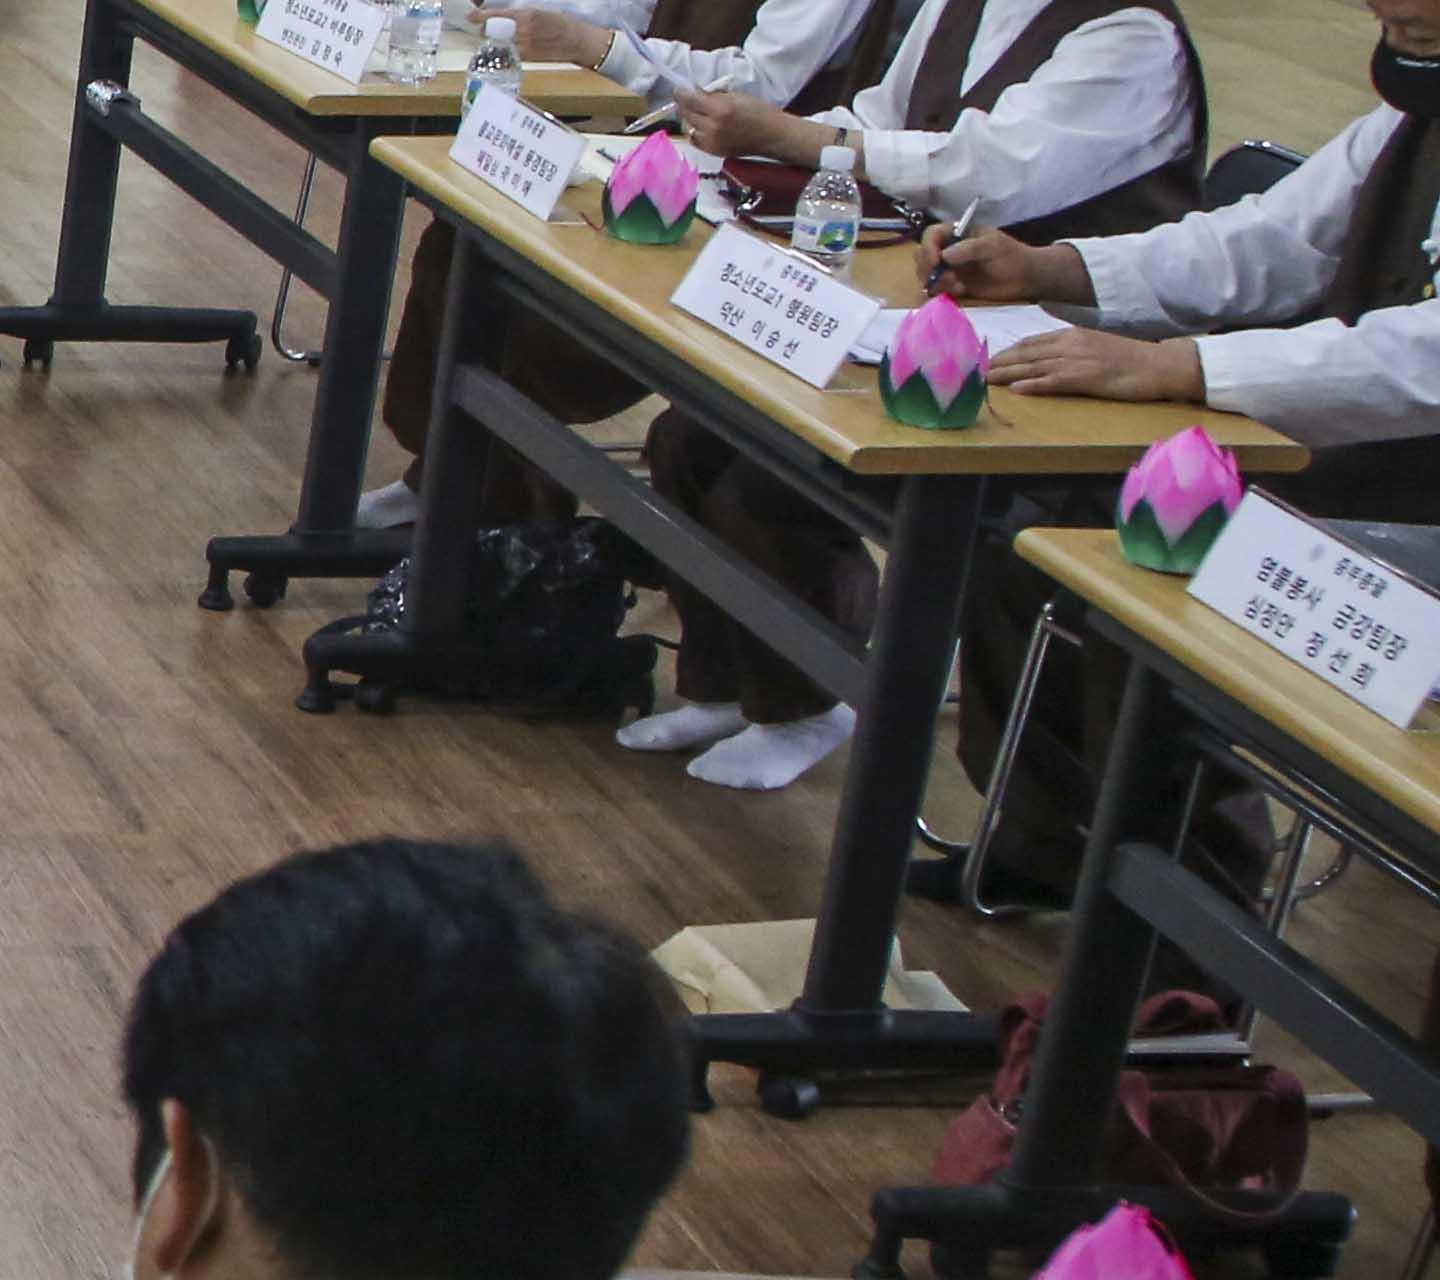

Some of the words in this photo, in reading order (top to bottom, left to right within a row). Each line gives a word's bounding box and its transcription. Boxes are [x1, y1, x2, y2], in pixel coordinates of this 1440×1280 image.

[720, 263, 784, 309] 청소년포교1
[720, 301, 744, 327] 덕산
[752, 320, 766, 340] 이
[765, 331, 780, 348] 승
[783, 339, 800, 359] 선
[1257, 557, 1322, 610] 염불봉사
[1332, 604, 1408, 661] 금강팀장
